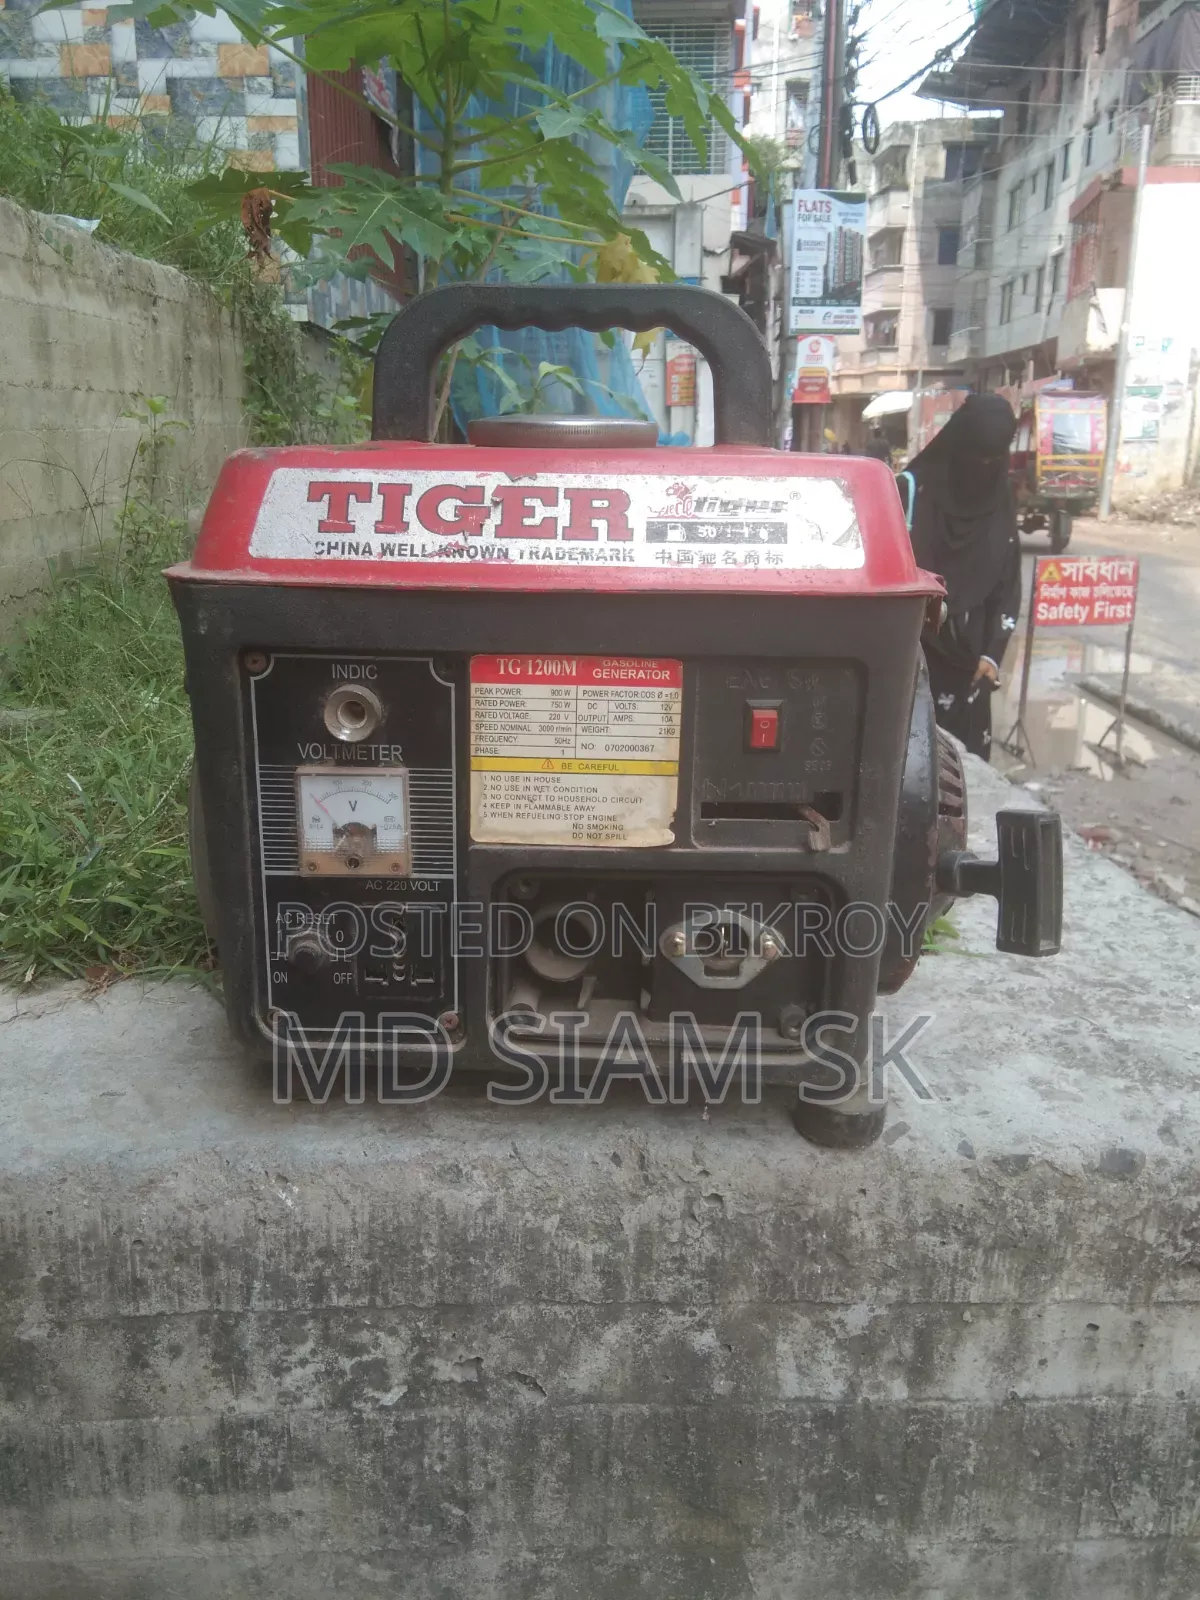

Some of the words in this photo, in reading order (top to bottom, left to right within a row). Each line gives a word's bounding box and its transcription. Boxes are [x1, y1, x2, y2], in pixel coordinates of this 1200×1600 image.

[798, 200, 832, 213] FLATS
[307, 481, 634, 541] TIGER
[314, 541, 373, 556] CHINA
[380, 542, 427, 558] WELL
[438, 544, 509, 560] KNOWN
[518, 546, 635, 562] TRADEMARK
[1037, 602, 1090, 624] Safety
[1094, 600, 1132, 618] First
[497, 658, 521, 676] TG
[526, 659, 577, 676] 1200M
[603, 660, 659, 668] GASOLINE
[332, 664, 378, 680] INDIC
[592, 669, 670, 680] GENERATOR
[474, 687, 494, 695] PEAK
[582, 690, 609, 698] POWER
[588, 702, 598, 710] DC
[660, 704, 673, 712] 12V
[578, 714, 606, 722] OUTPUT
[475, 723, 498, 731] SPEED
[298, 742, 404, 762] VOLTMETER
[604, 744, 654, 752] 0702000367
[561, 762, 572, 770] BE
[534, 776, 561, 784] HOUSE
[504, 784, 520, 792] USE
[553, 786, 598, 794] CONDITION
[504, 794, 542, 802] CONNECT
[610, 796, 644, 804] CIRCUIT
[348, 800, 358, 812] V
[524, 804, 571, 812] FLAMMABLE
[588, 814, 618, 822] ENGINE
[572, 832, 584, 840] DO
[366, 880, 382, 890] AC
[386, 880, 407, 890] 220
[410, 880, 441, 892] VOLT
[276, 913, 292, 924] AC
[296, 913, 338, 924] RESET
[273, 972, 288, 984] ON
[333, 972, 353, 984] OFF
